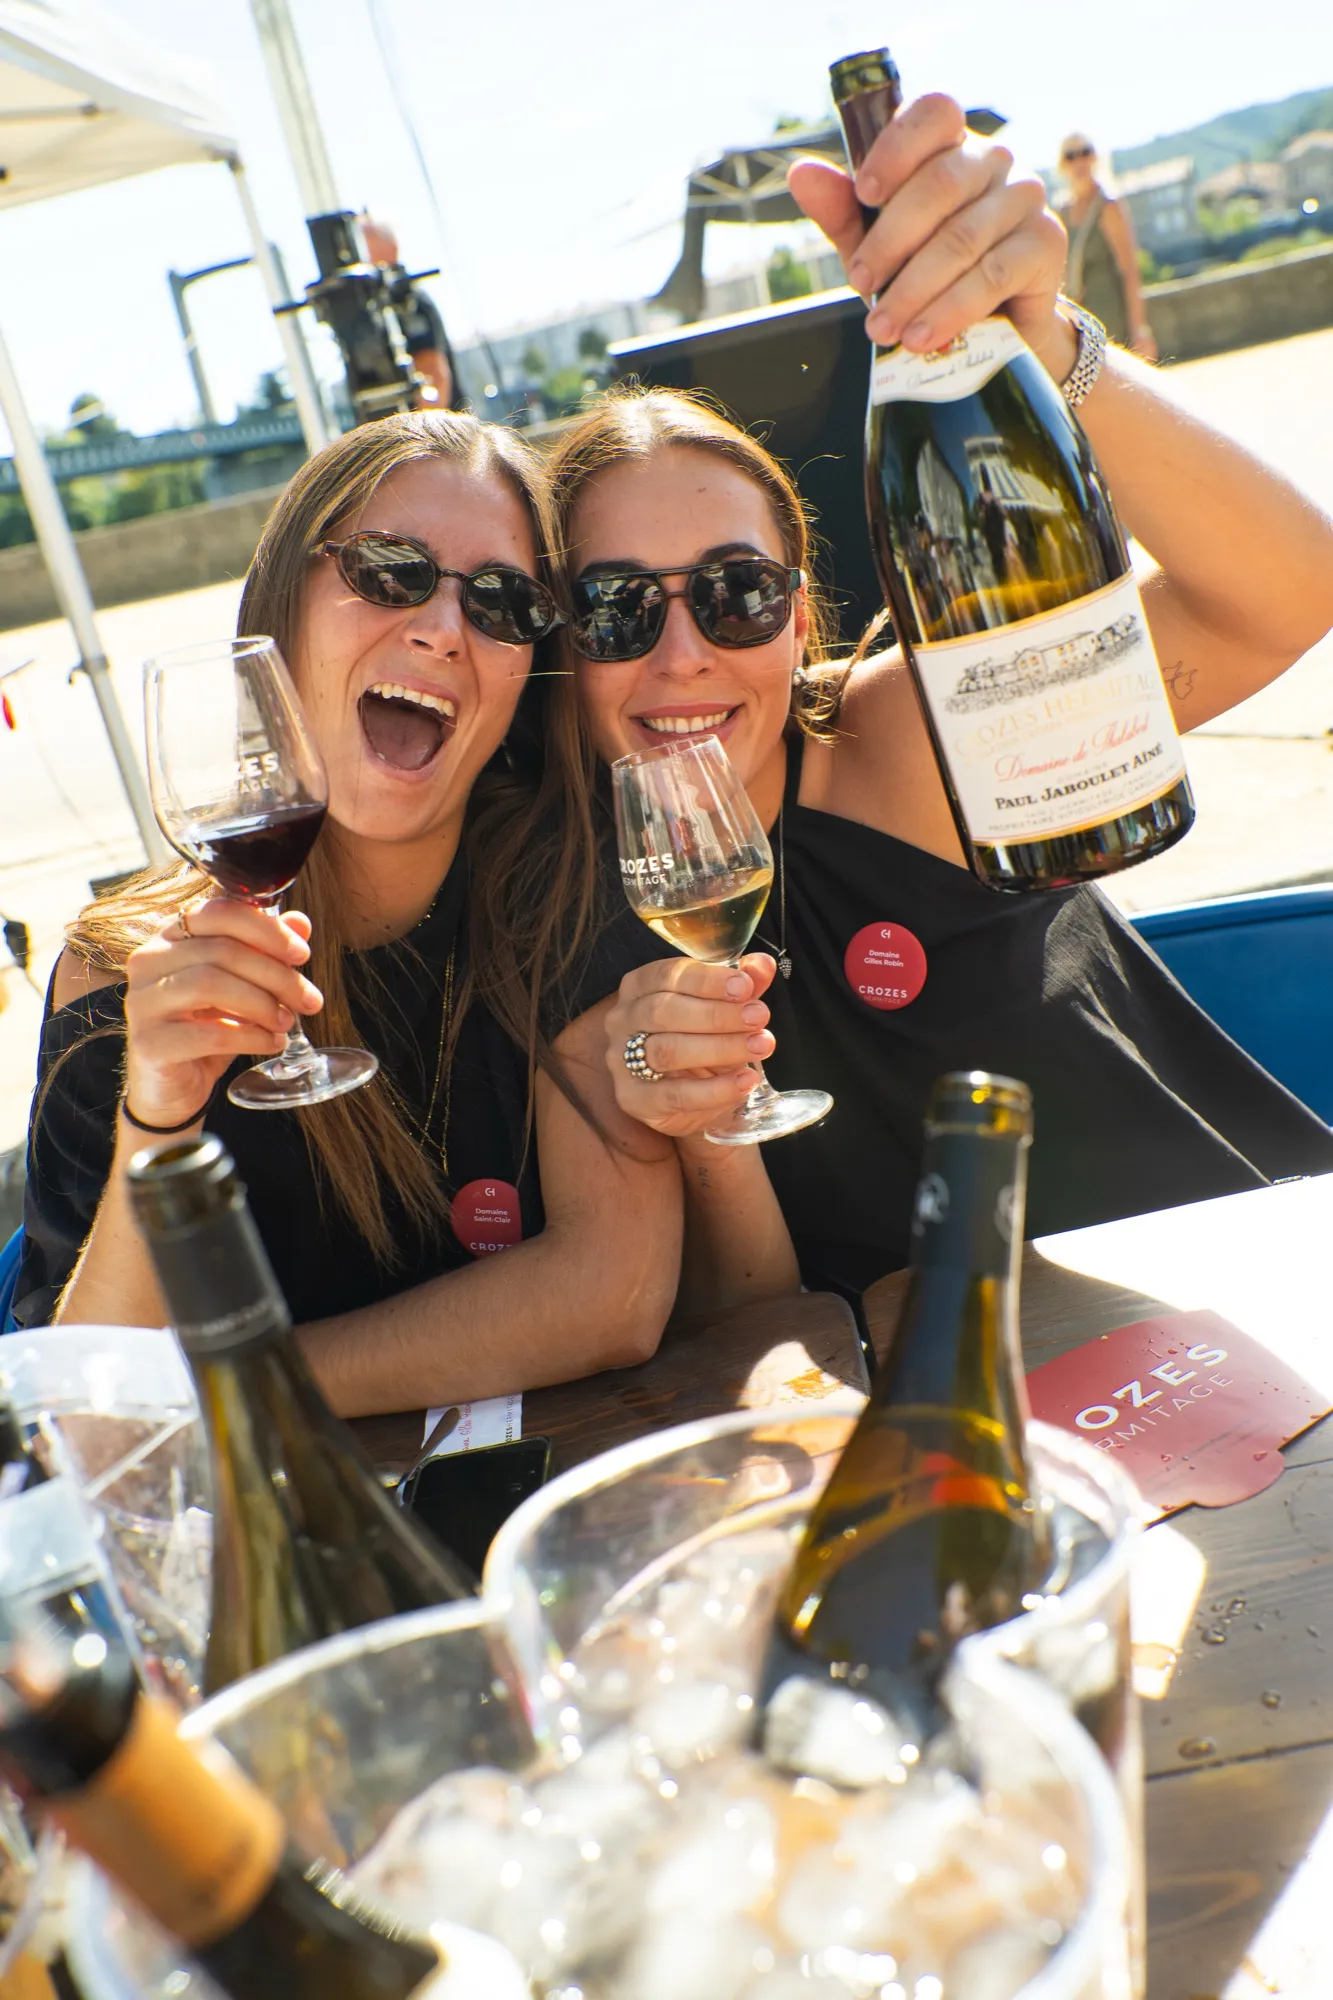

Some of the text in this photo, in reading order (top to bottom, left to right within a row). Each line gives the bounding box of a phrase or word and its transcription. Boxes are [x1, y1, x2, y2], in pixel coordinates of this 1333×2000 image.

[954, 708, 1038, 756] COZES
[994, 752, 1067, 783] Domaine
[1073, 738, 1088, 762] de
[995, 795, 1038, 810] PAUL
[1041, 762, 1130, 801] JABOULET
[869, 950, 900, 959] Domaine
[864, 957, 904, 967] Gilles Robin
[859, 985, 908, 999] CROZES
[475, 1208, 508, 1216] Domaine
[470, 1242, 513, 1252] CROZ
[1074, 1343, 1228, 1430] OZES
